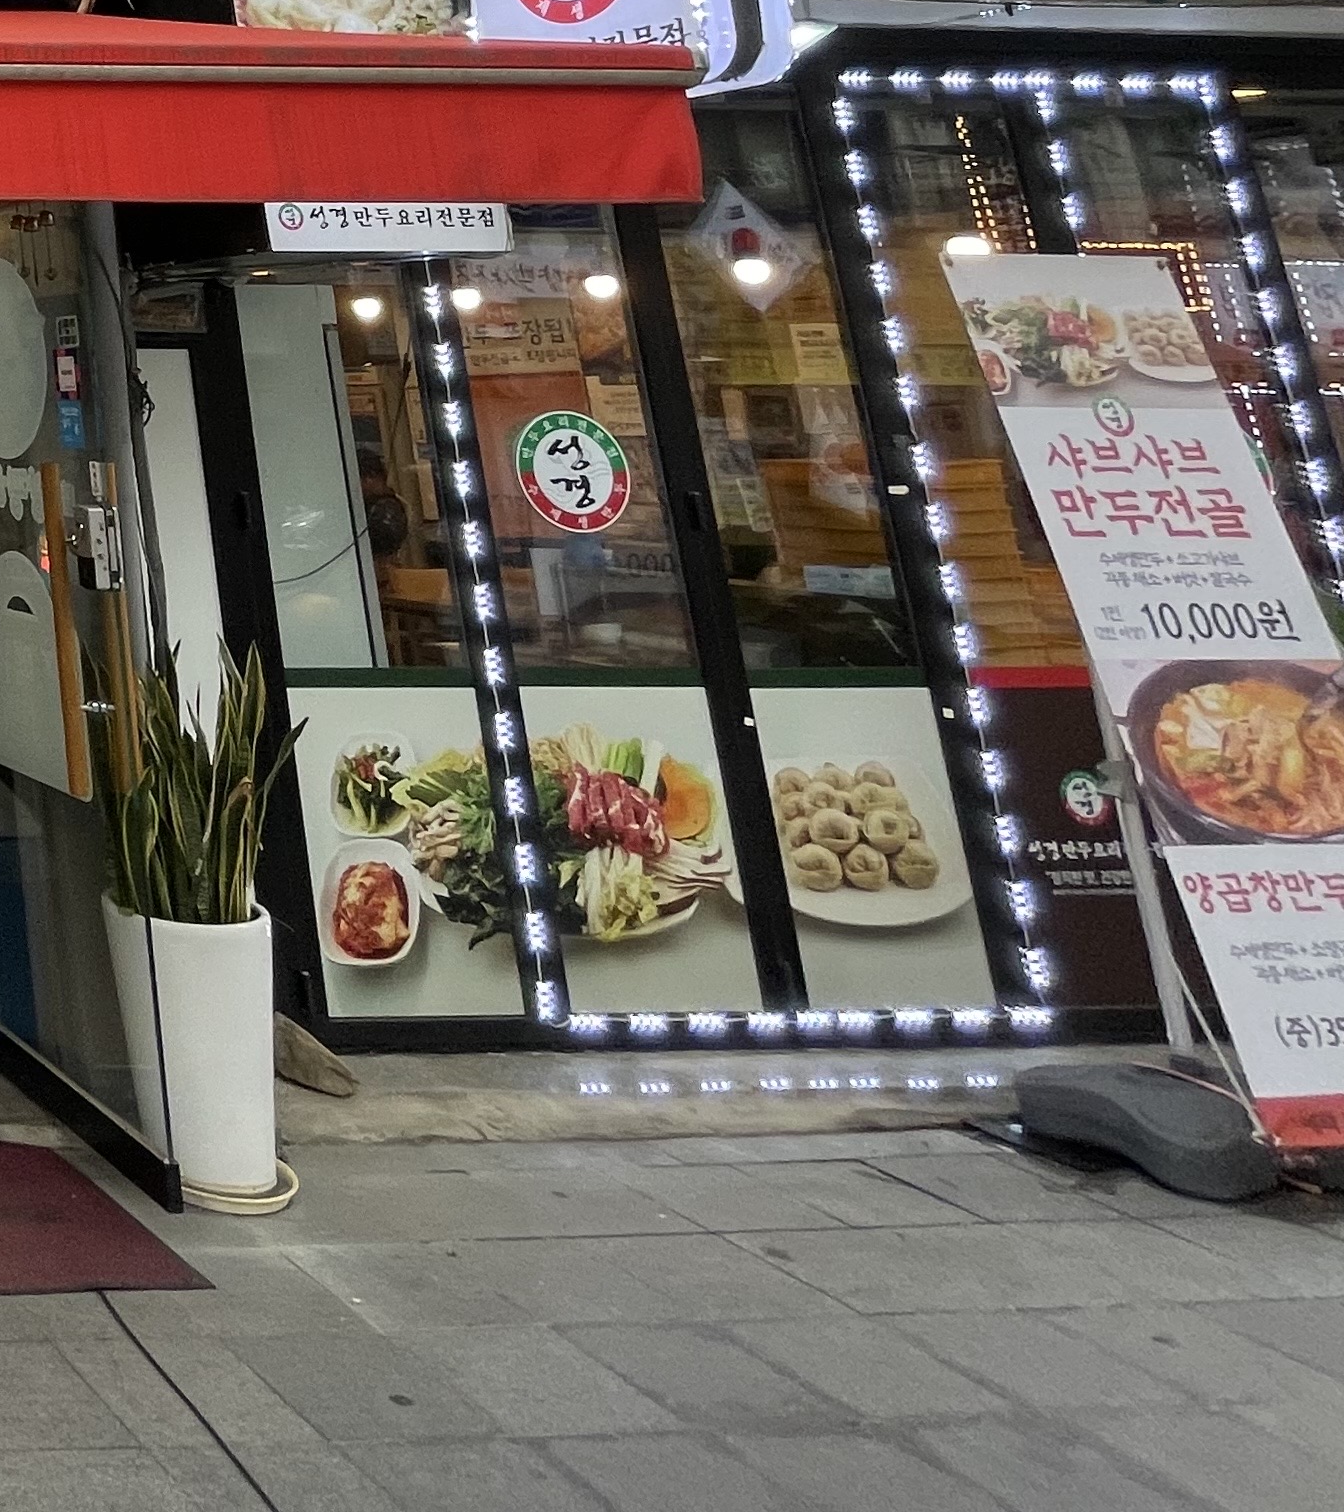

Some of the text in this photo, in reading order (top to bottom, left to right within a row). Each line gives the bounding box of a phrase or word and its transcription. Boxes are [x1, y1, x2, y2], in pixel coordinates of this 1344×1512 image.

[547, 435, 597, 509] 성경
[1047, 432, 1221, 480] 샤브샤브
[1050, 485, 1253, 540] 만두전골
[1139, 598, 1302, 645] 10,000원
